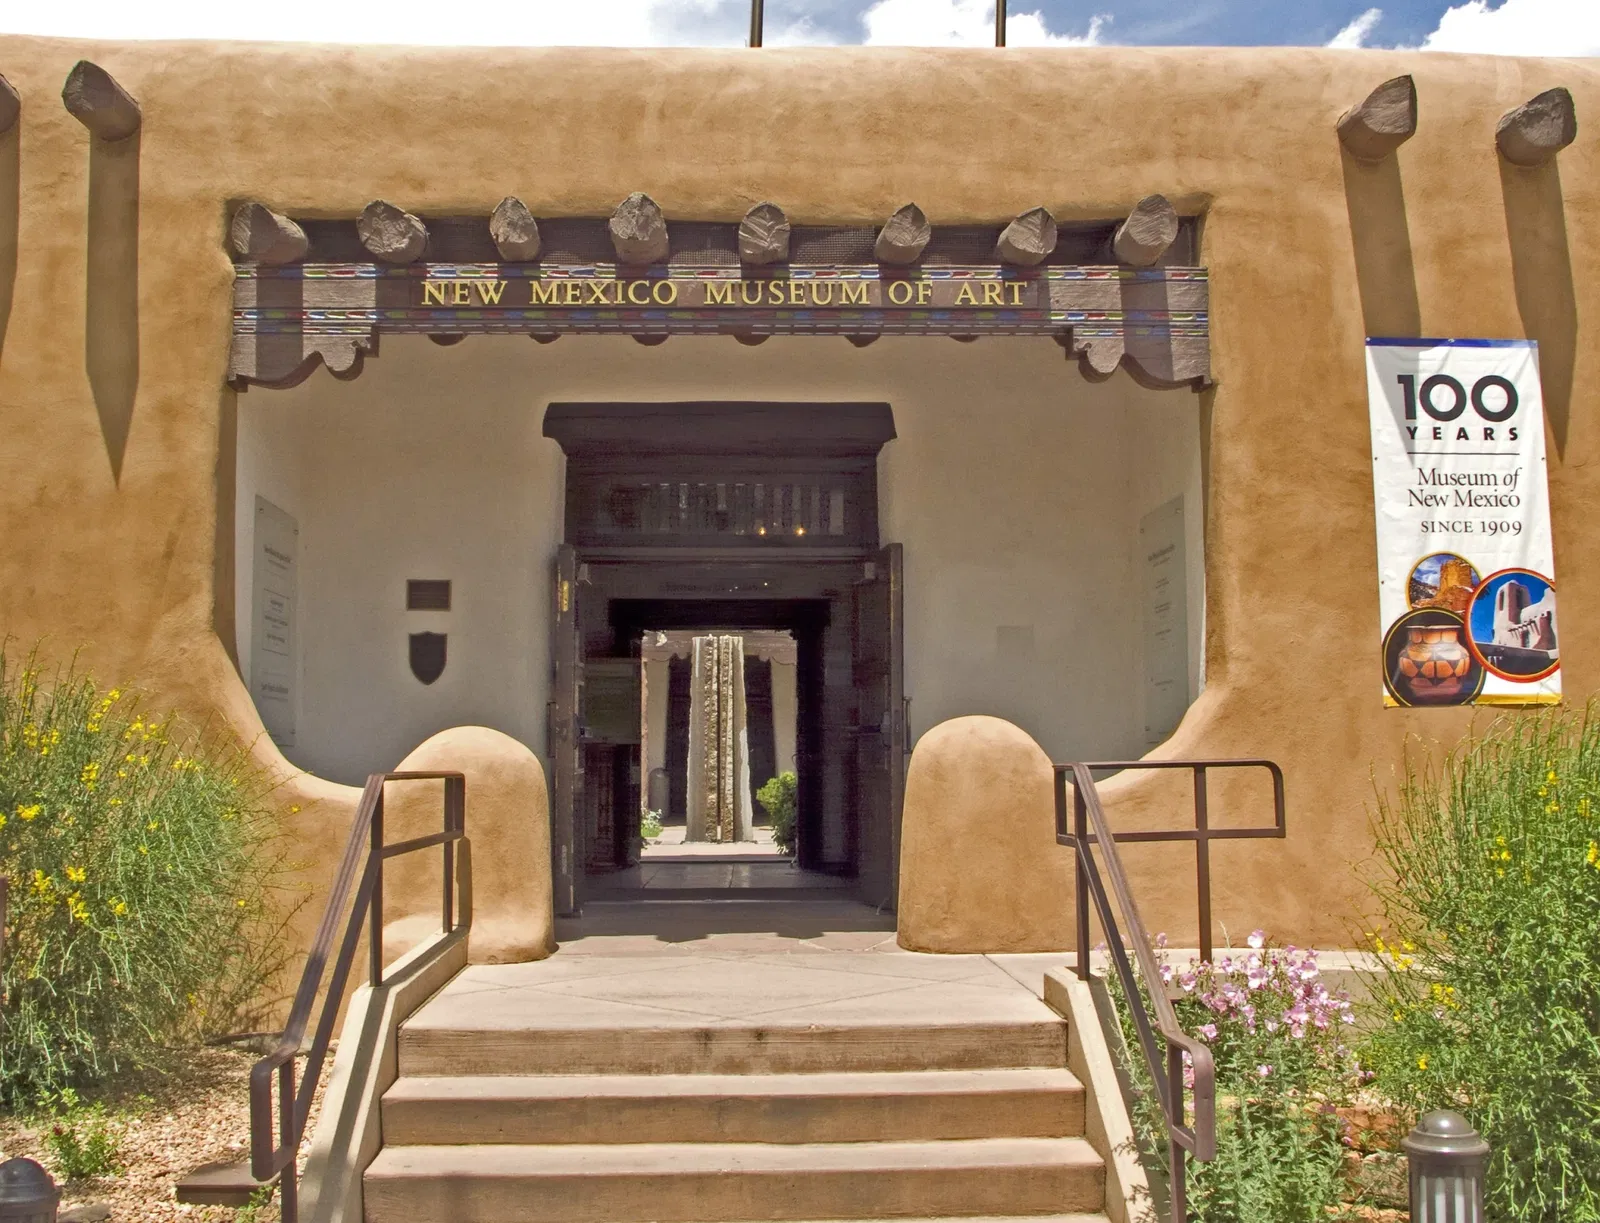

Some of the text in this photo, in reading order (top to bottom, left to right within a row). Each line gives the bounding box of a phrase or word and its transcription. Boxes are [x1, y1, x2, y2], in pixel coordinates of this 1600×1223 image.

[421, 280, 1028, 305] NEW MEXICO MUSEUM OF ART
[1397, 374, 1519, 422] 100
[1406, 426, 1518, 441] YEARS
[1417, 467, 1523, 492] Museum of
[1407, 489, 1520, 507] New Mexico
[1420, 520, 1522, 536] SINCE 1909
